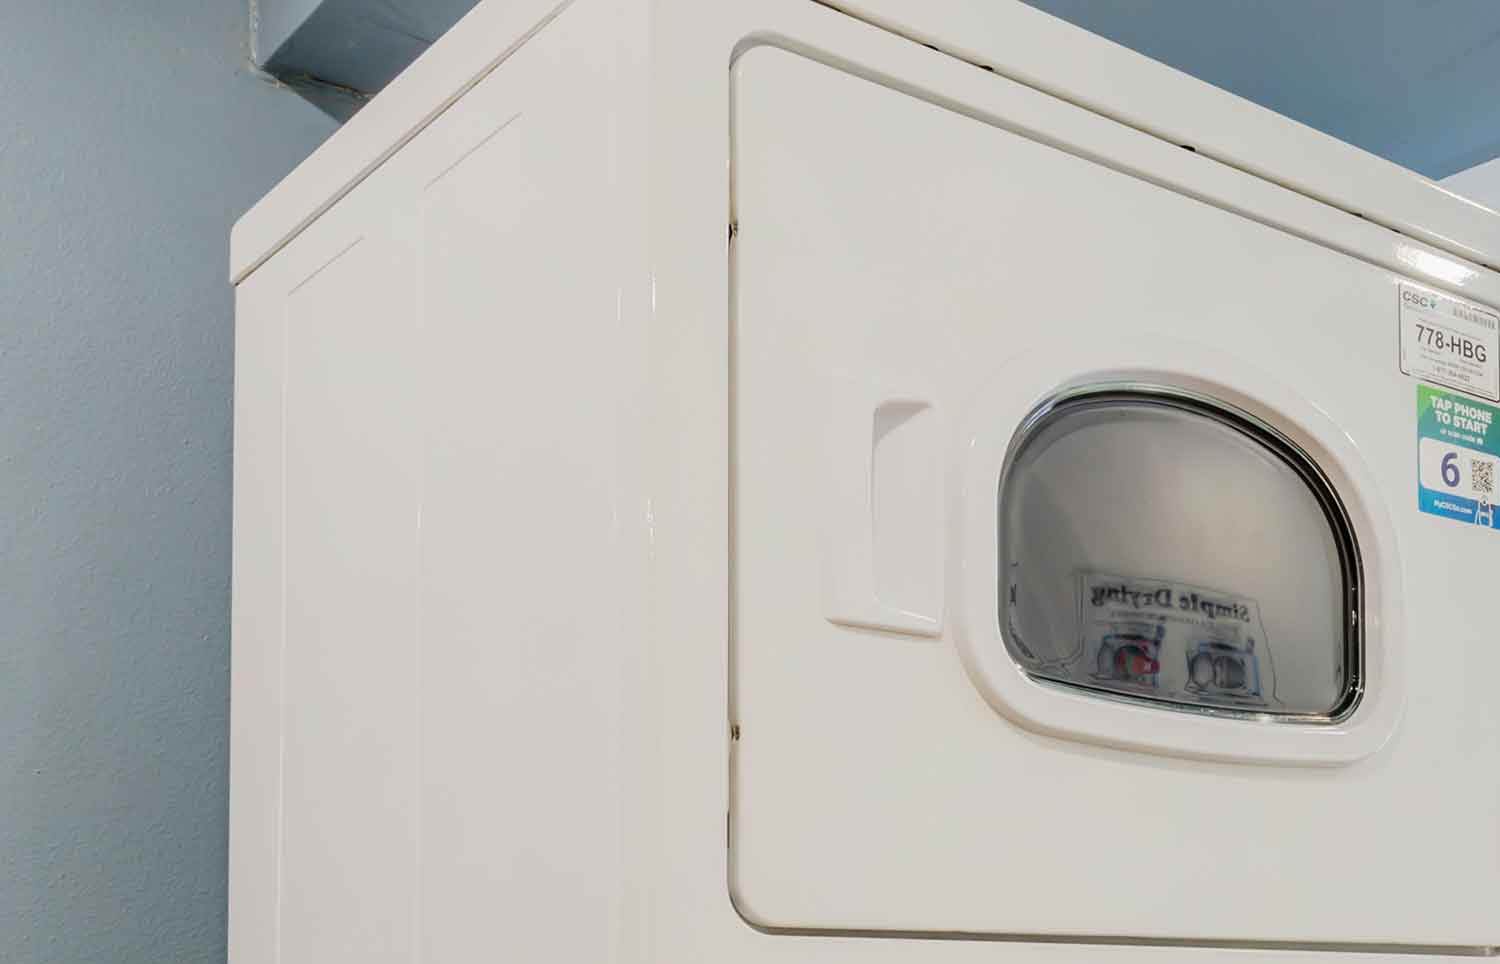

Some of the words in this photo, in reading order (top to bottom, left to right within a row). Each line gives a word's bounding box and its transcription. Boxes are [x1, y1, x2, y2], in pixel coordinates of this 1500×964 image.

[1402, 291, 1428, 307] CSC
[1415, 323, 1486, 362] 778-HBG
[1430, 396, 1452, 411] TAP
[1454, 403, 1492, 424] PHONE
[1435, 411, 1451, 425] TO
[1453, 416, 1488, 435] START
[1441, 453, 1460, 487] 6
